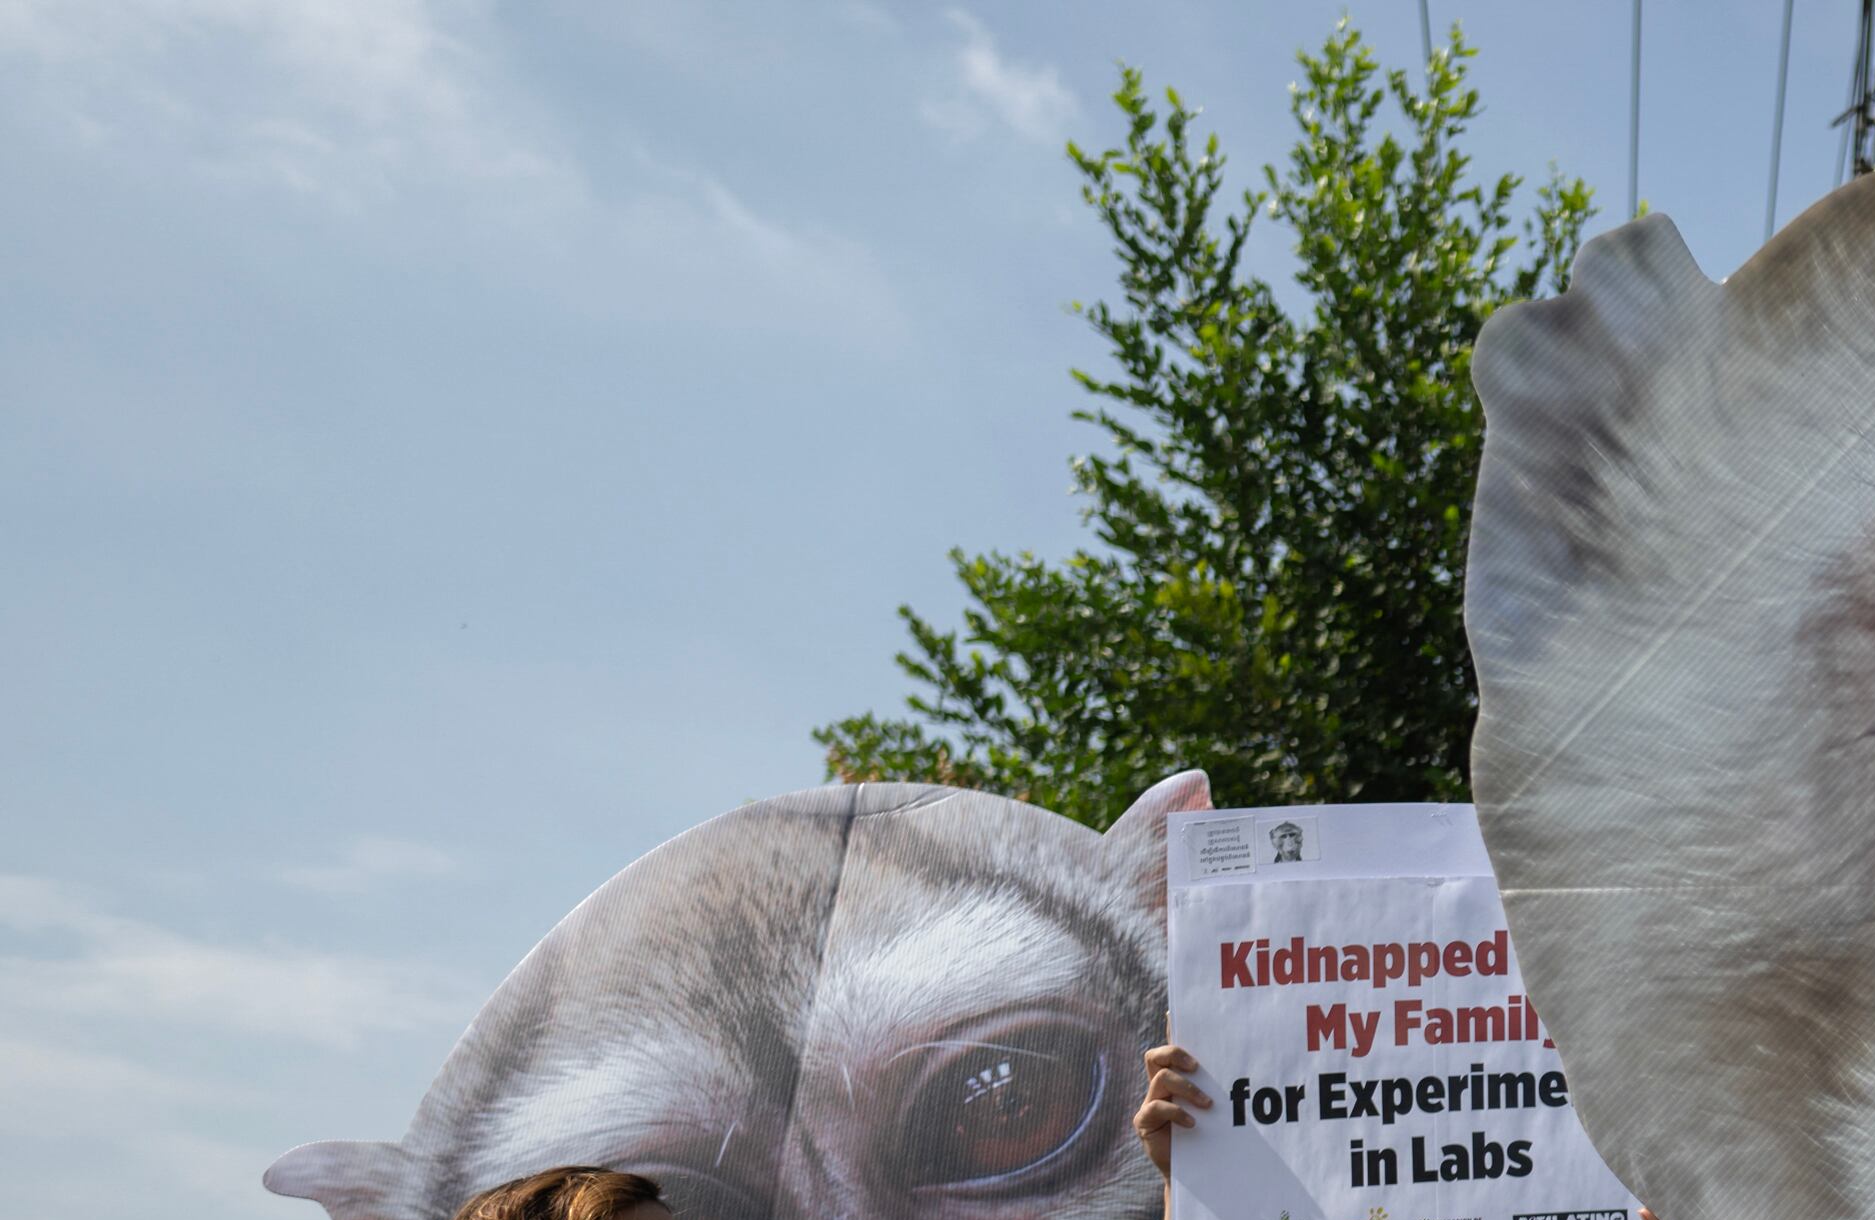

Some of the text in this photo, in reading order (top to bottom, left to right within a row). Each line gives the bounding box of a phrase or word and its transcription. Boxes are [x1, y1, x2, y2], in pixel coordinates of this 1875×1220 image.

[1220, 930, 1508, 988] Kidnapped
[1306, 996, 1558, 1057] My Famil
[1230, 1064, 1572, 1126] for Experime
[1351, 1132, 1533, 1187] in Labs
